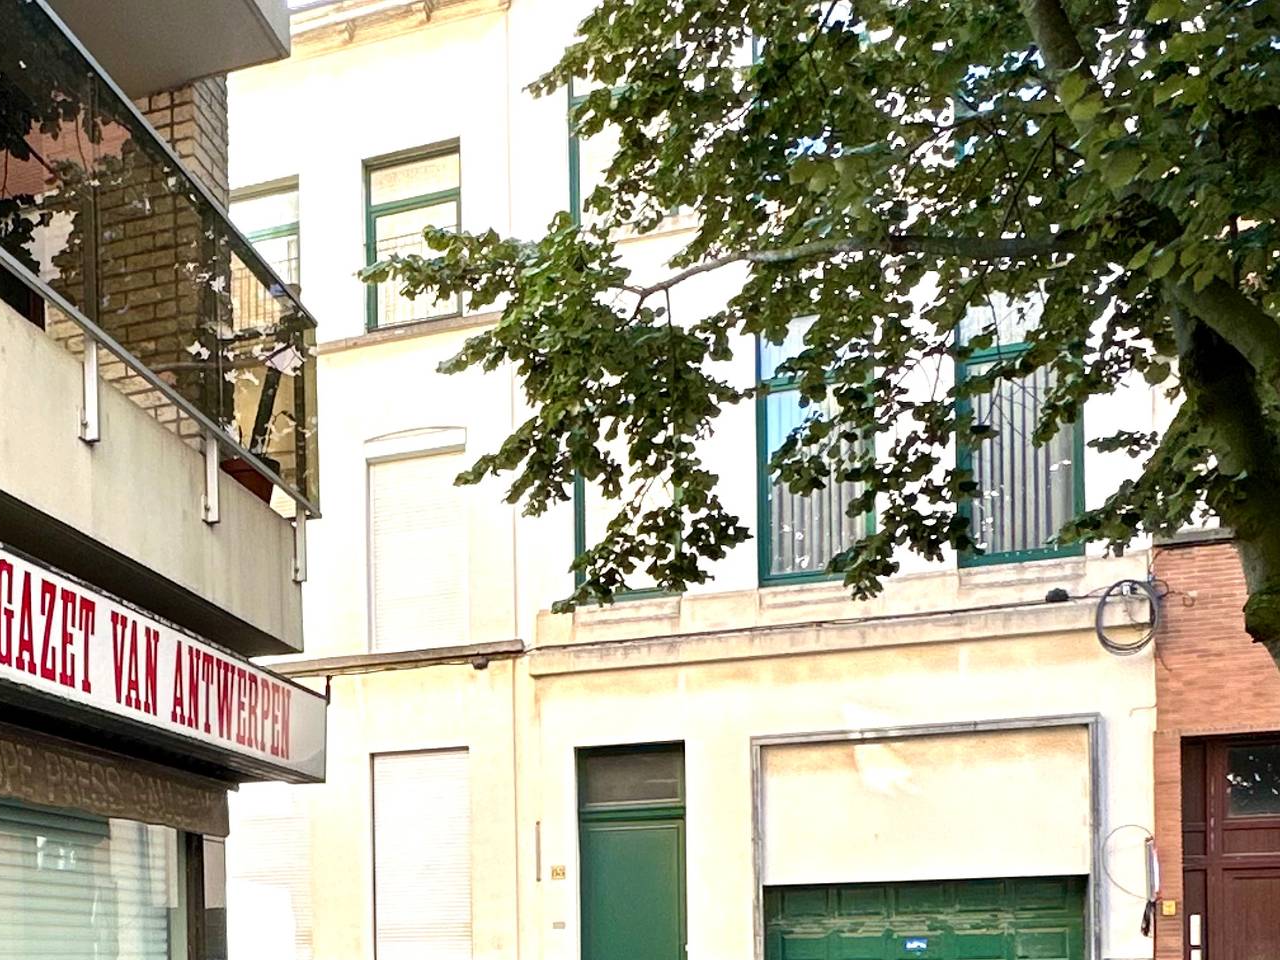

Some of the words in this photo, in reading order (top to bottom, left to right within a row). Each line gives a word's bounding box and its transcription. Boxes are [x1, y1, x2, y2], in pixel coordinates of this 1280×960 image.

[111, 610, 160, 717] VAN
[171, 640, 292, 761] ANTWERPEN
[43, 751, 125, 810] PRESS
